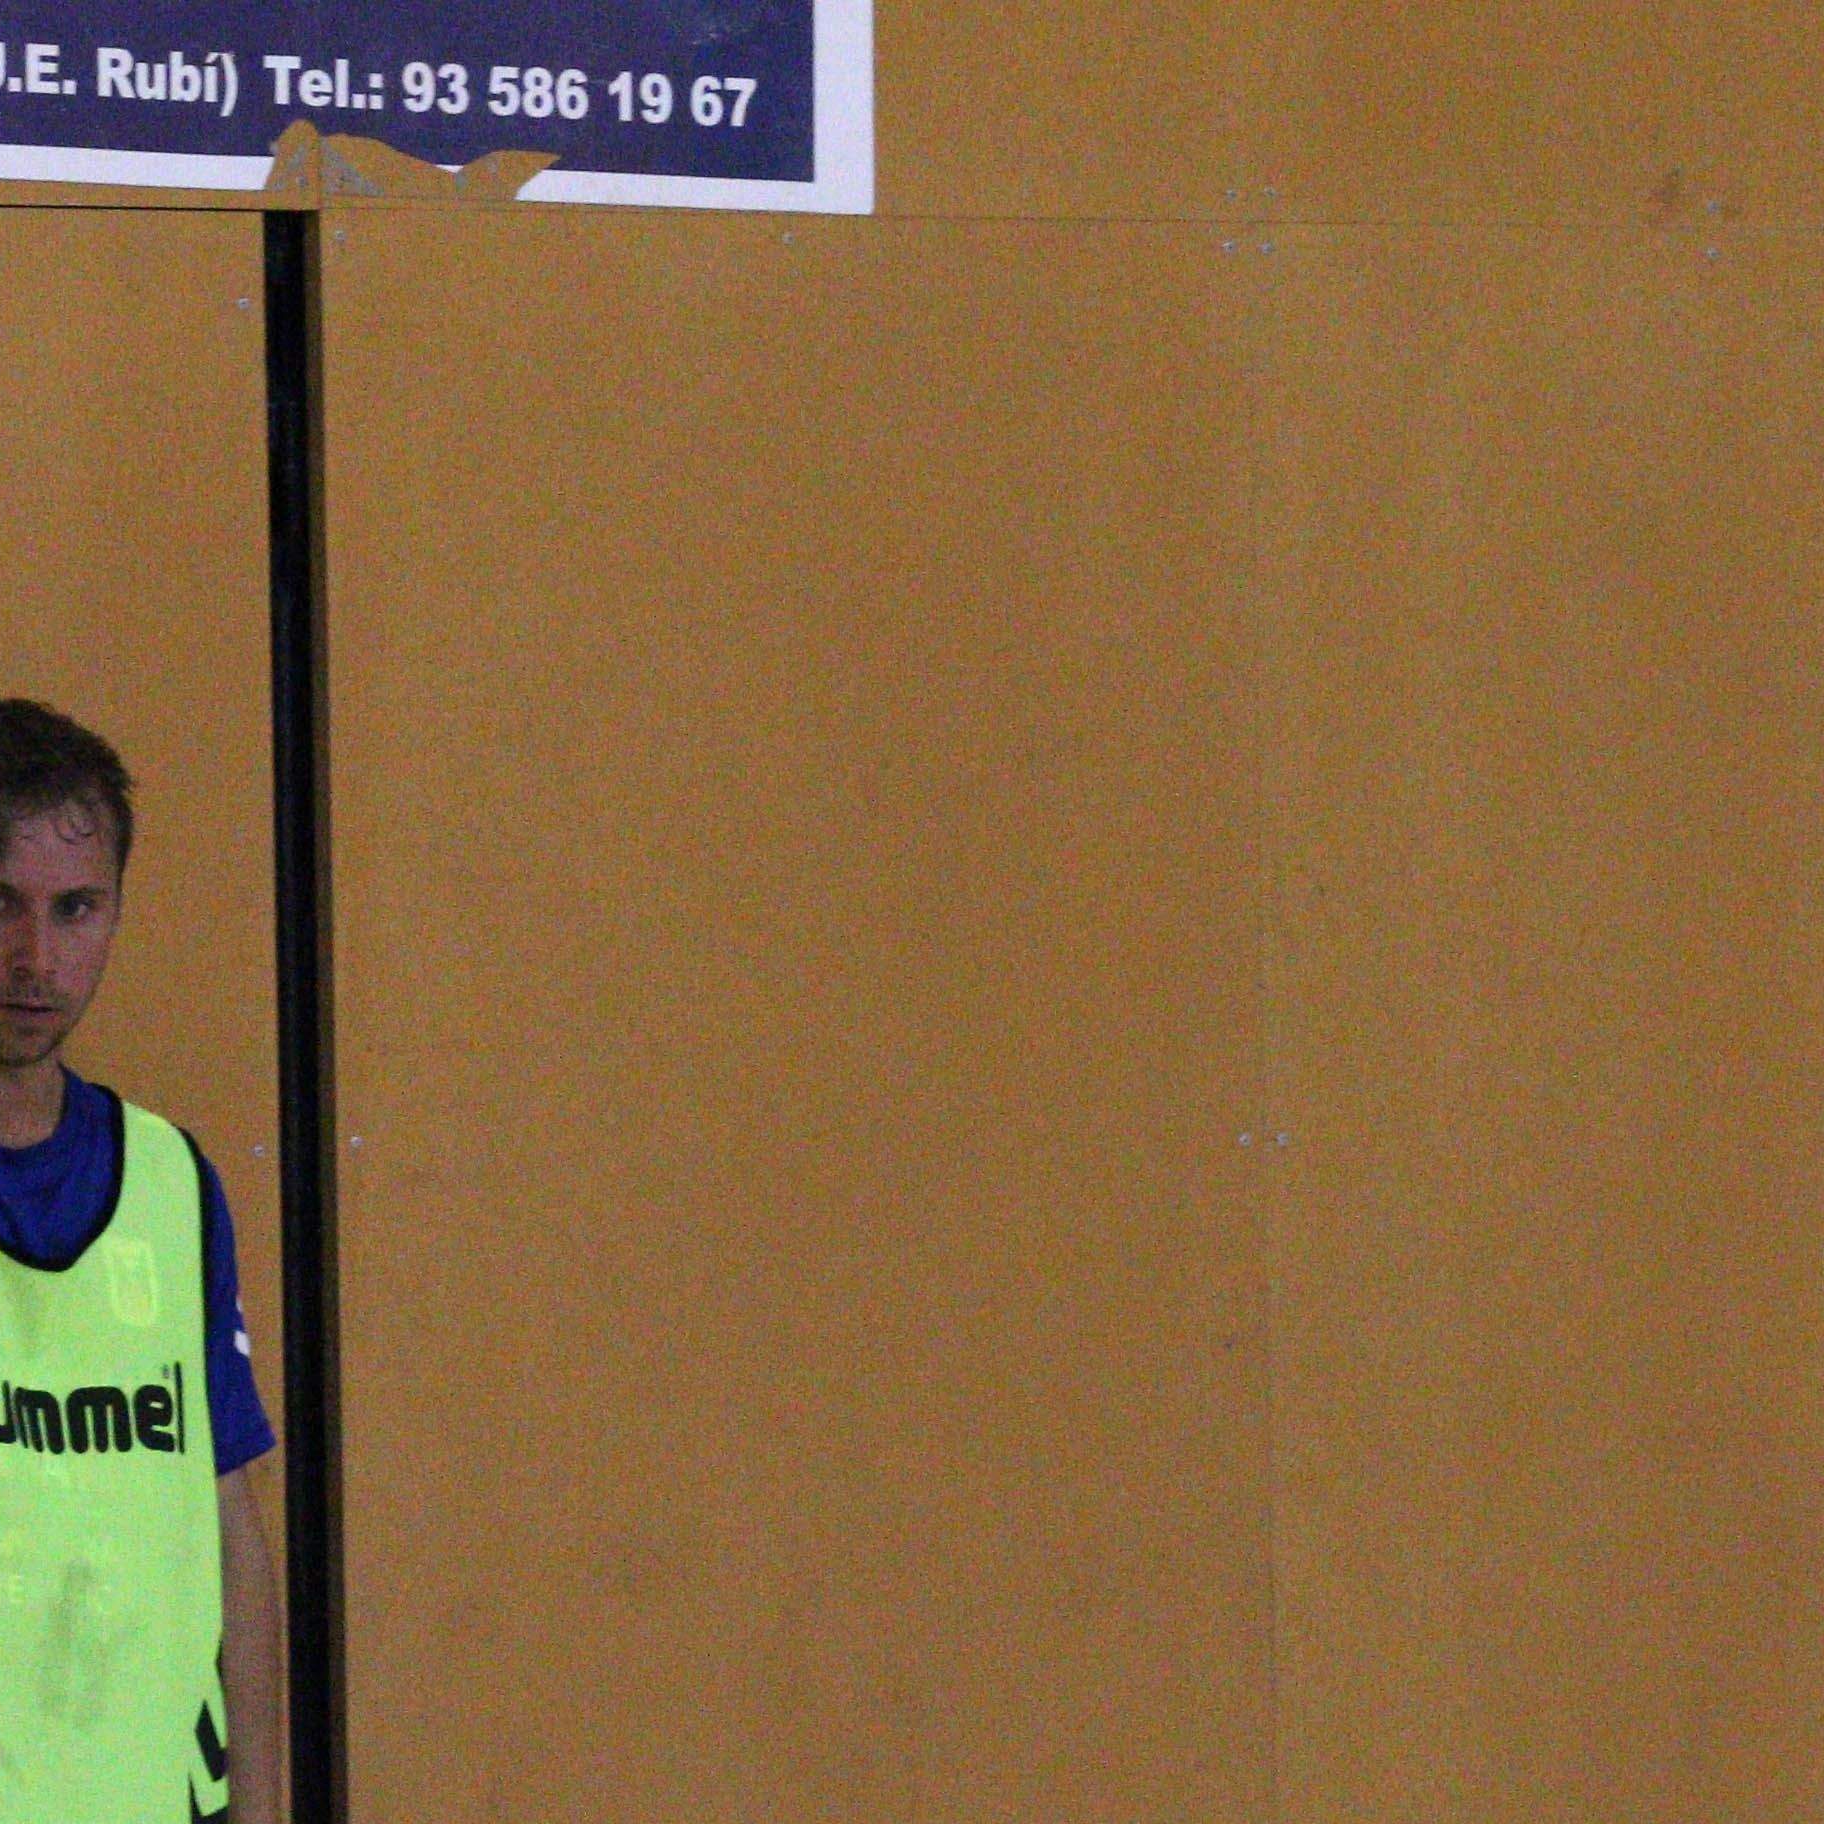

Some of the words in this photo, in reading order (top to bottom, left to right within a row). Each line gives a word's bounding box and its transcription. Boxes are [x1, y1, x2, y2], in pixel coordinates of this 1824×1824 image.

[97, 47, 238, 117] Rubí)
[263, 55, 384, 110] Tel.:
[402, 61, 470, 115] 93
[487, 65, 589, 120] 586
[608, 71, 673, 124] 19
[691, 75, 757, 127] 67
